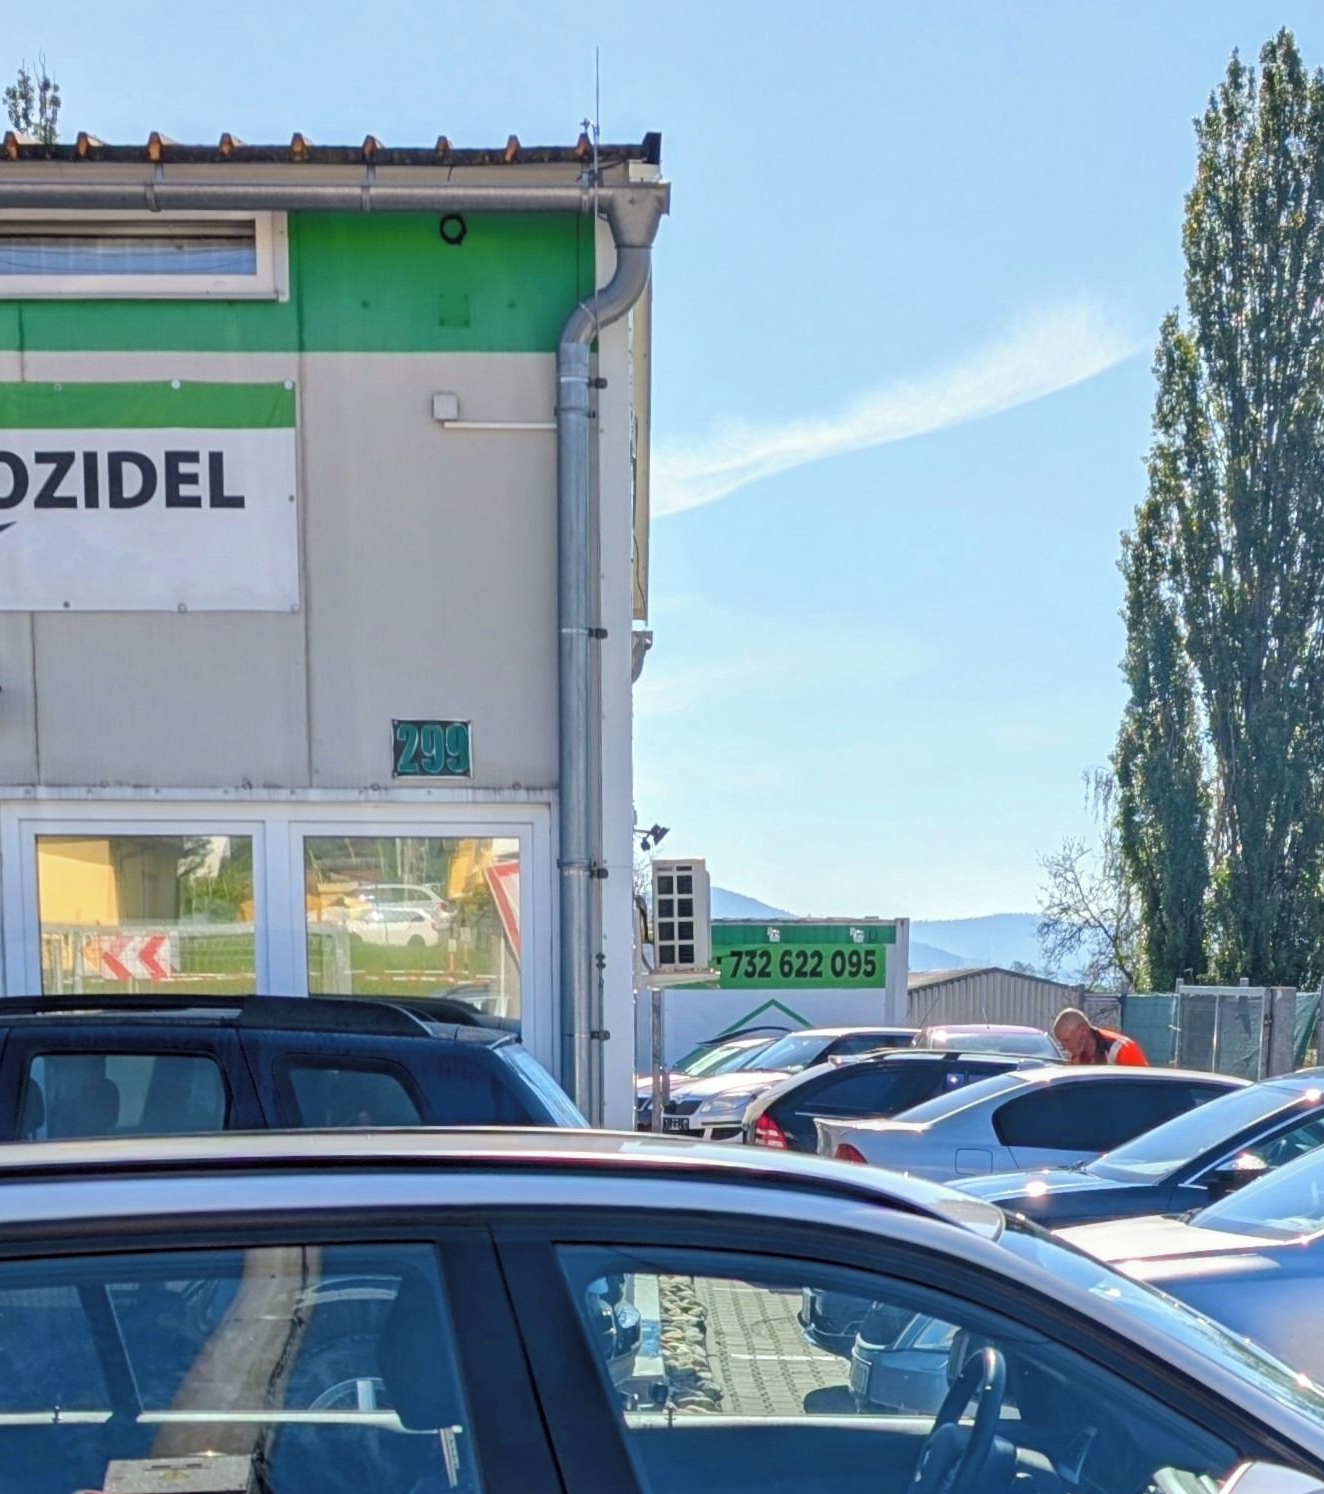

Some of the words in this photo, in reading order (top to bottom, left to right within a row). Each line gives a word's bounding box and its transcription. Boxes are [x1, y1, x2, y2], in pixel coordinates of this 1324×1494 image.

[397, 723, 469, 774] 299
[730, 949, 772, 978] 732
[779, 949, 823, 978] 622
[830, 949, 876, 978] 095
